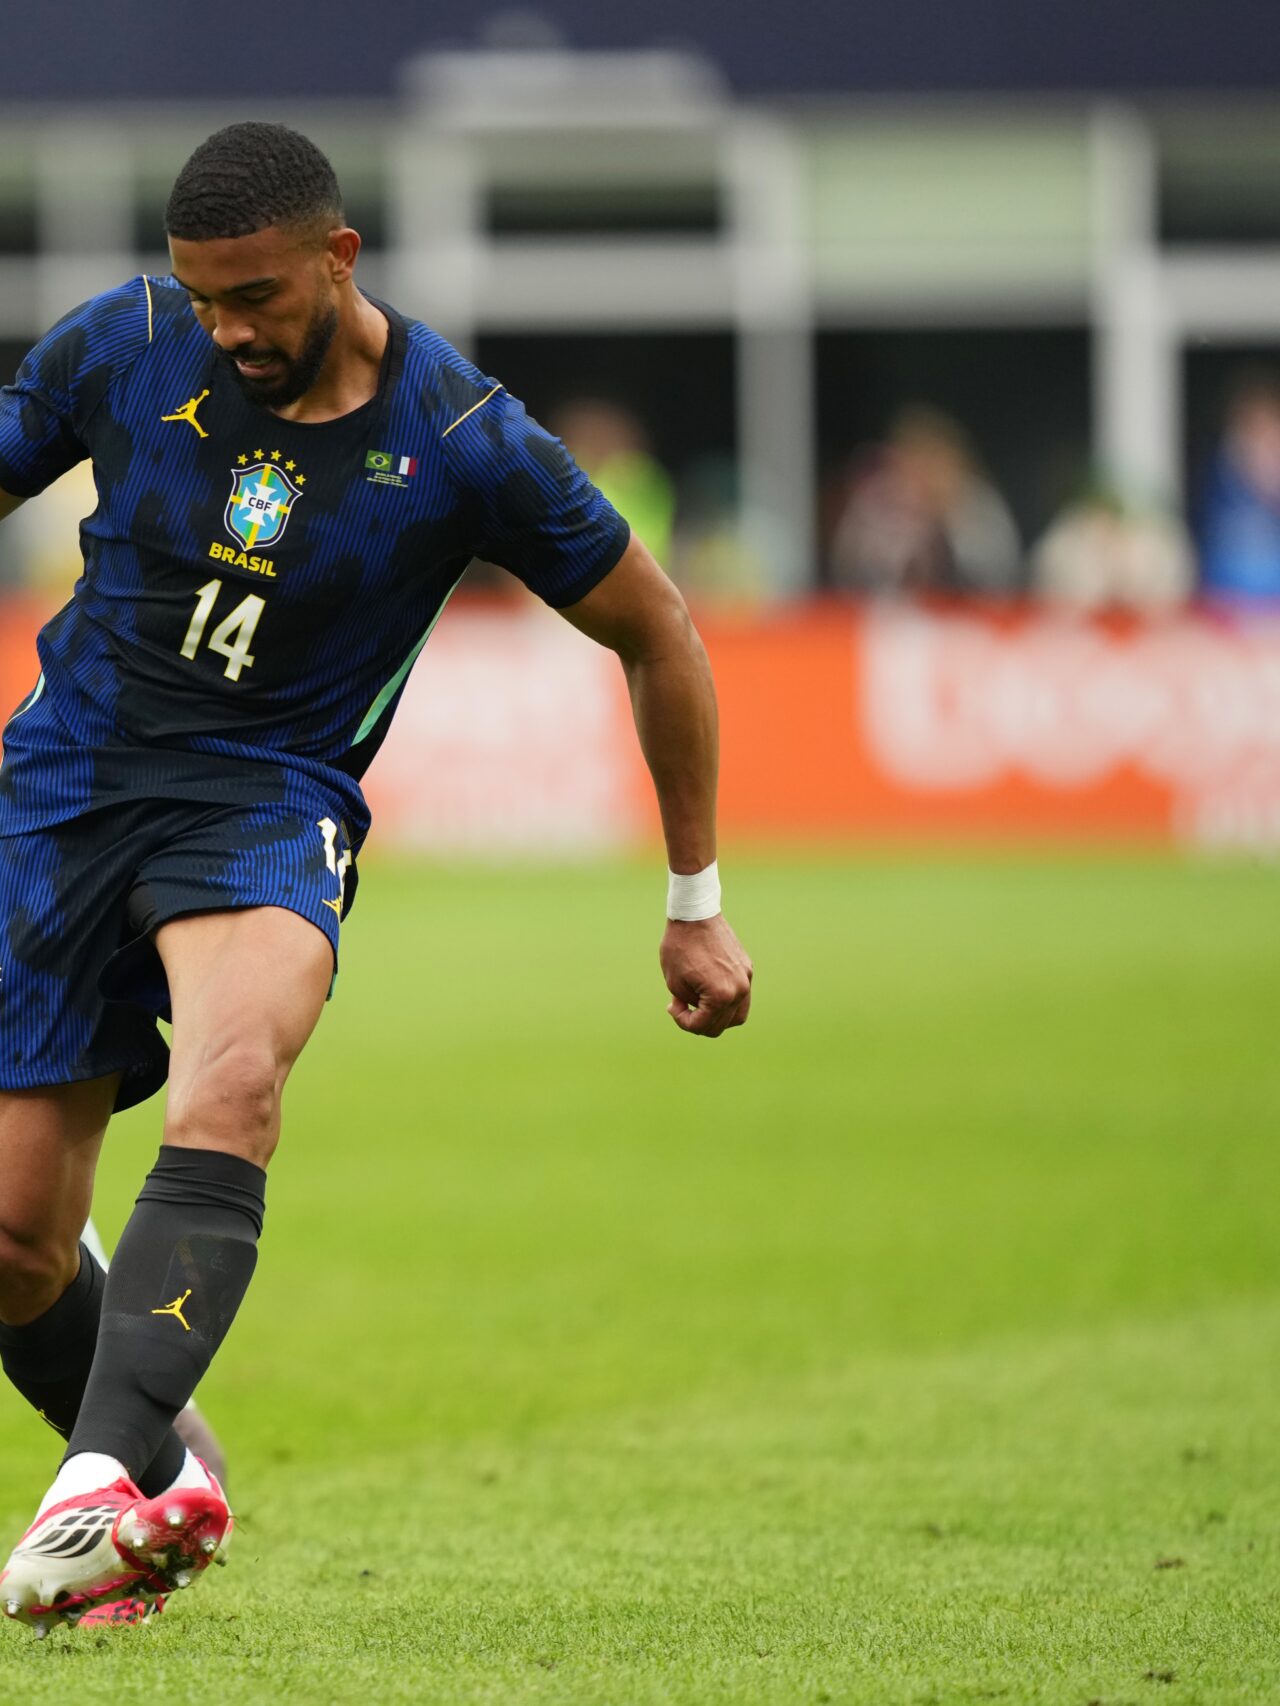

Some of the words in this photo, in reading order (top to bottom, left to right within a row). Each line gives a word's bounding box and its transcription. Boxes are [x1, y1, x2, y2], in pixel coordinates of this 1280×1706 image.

[248, 496, 272, 511] CBF
[208, 542, 277, 577] BRASIL
[180, 579, 266, 682] 14
